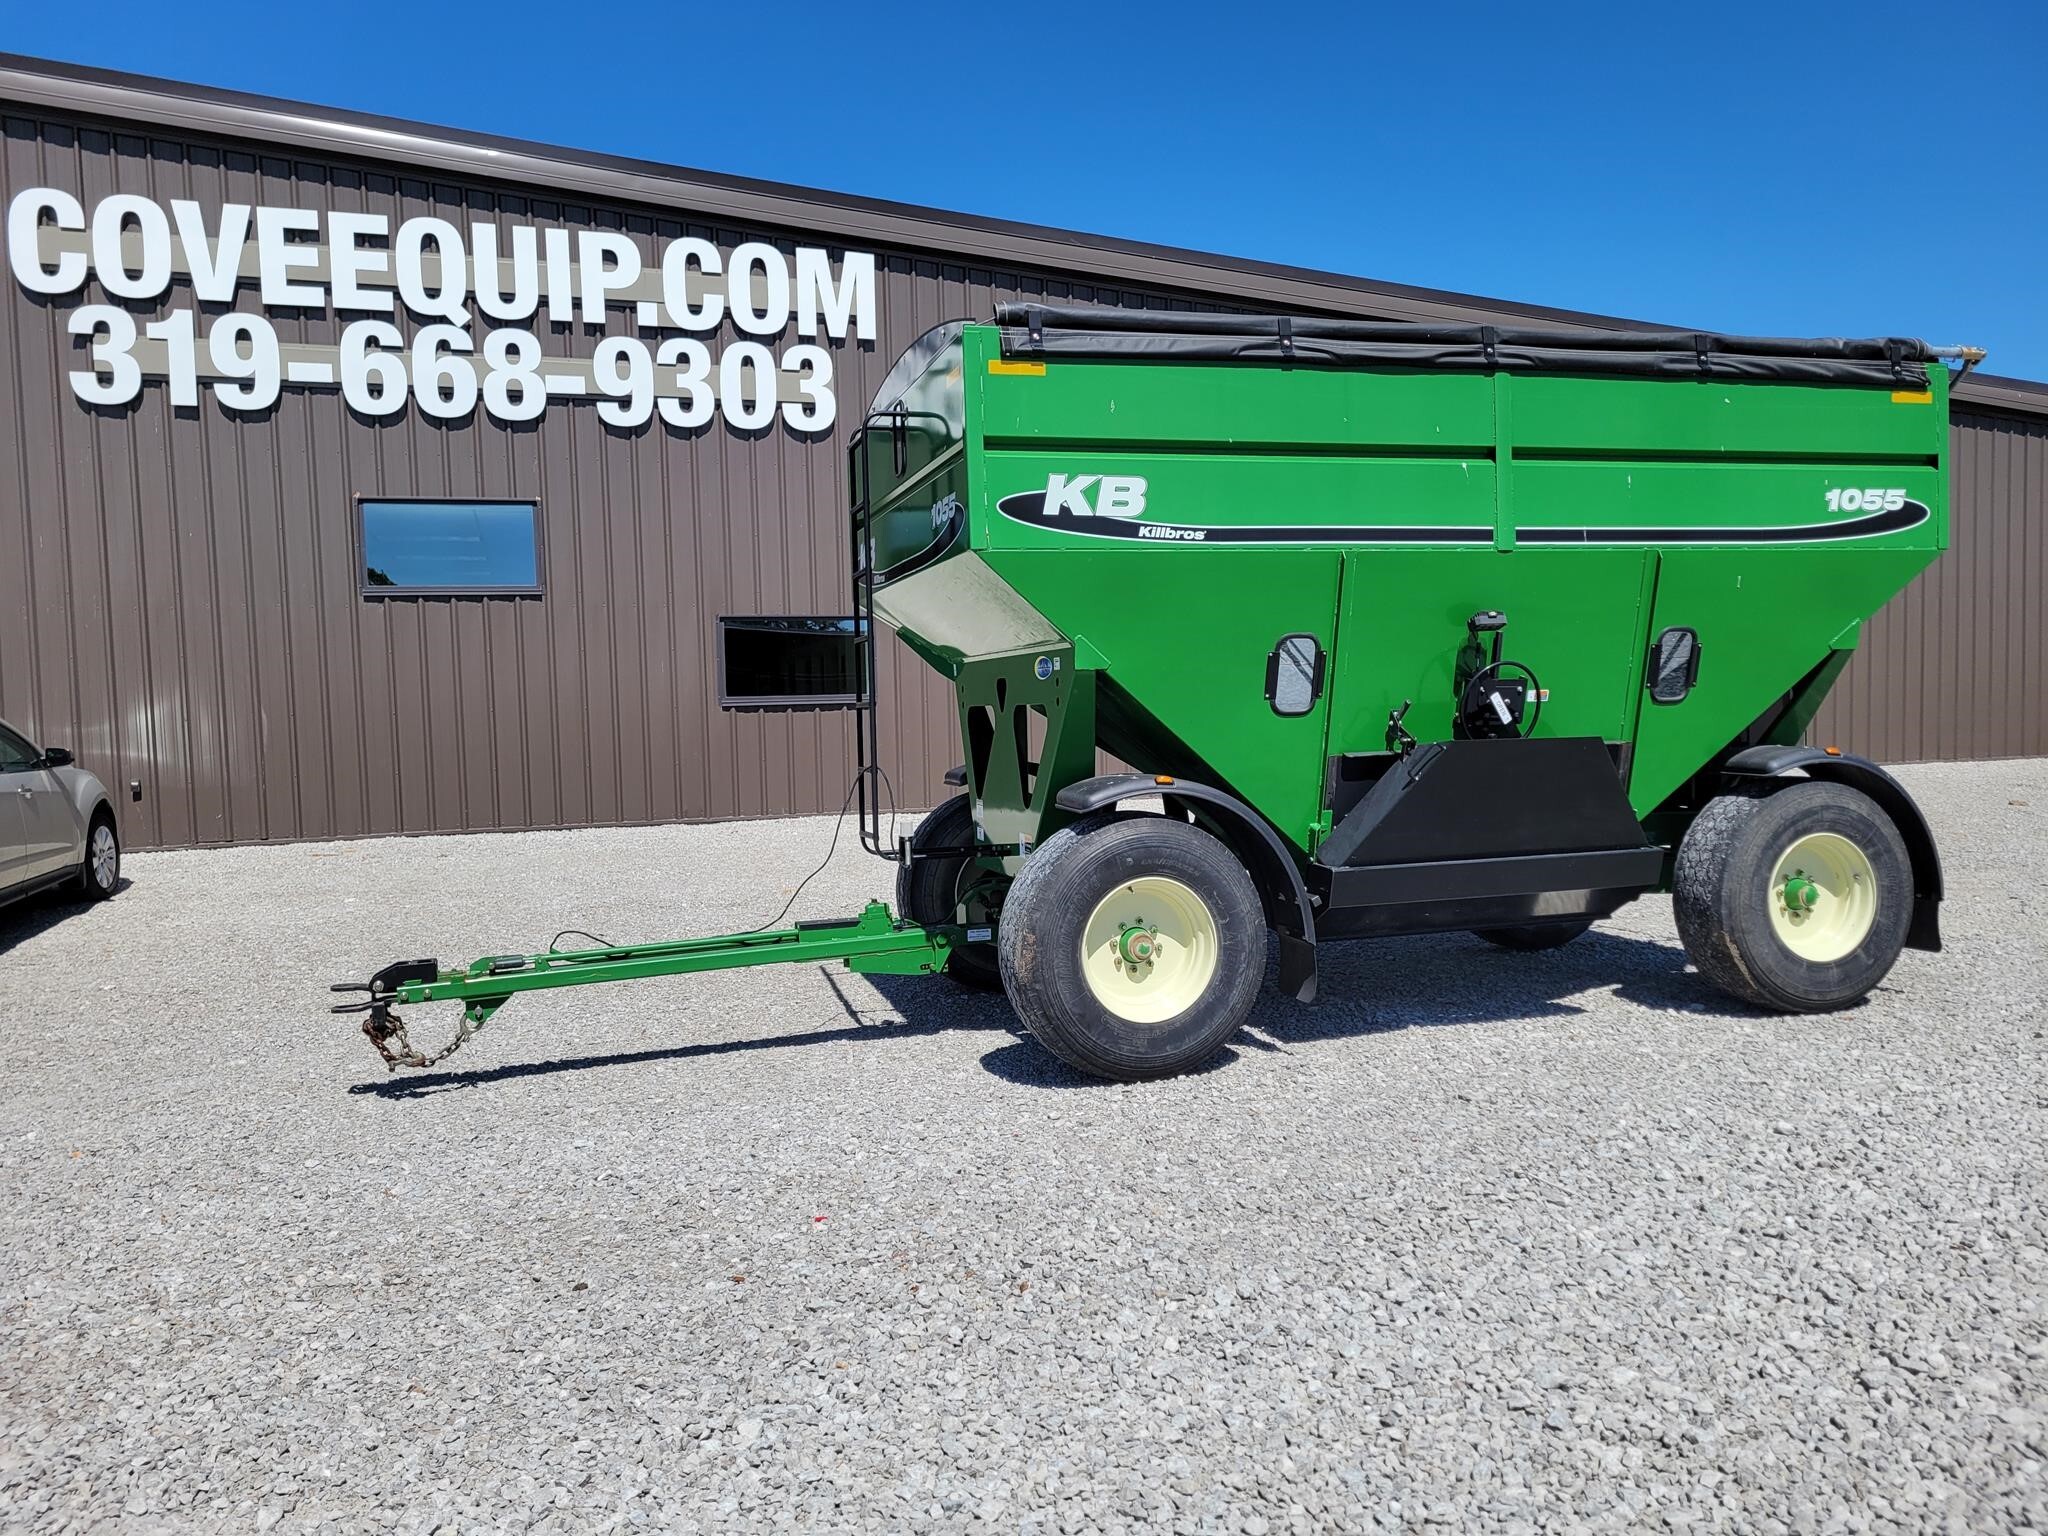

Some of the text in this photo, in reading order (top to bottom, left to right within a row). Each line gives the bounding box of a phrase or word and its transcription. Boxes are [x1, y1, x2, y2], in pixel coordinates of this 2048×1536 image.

[8, 187, 877, 341] COVEEQUIP.COM
[67, 304, 837, 432] 319-668-9303
[931, 491, 956, 530] 1055
[1042, 473, 1148, 518] KB
[1825, 488, 1907, 512] 1055
[1138, 526, 1207, 540] Killbros
